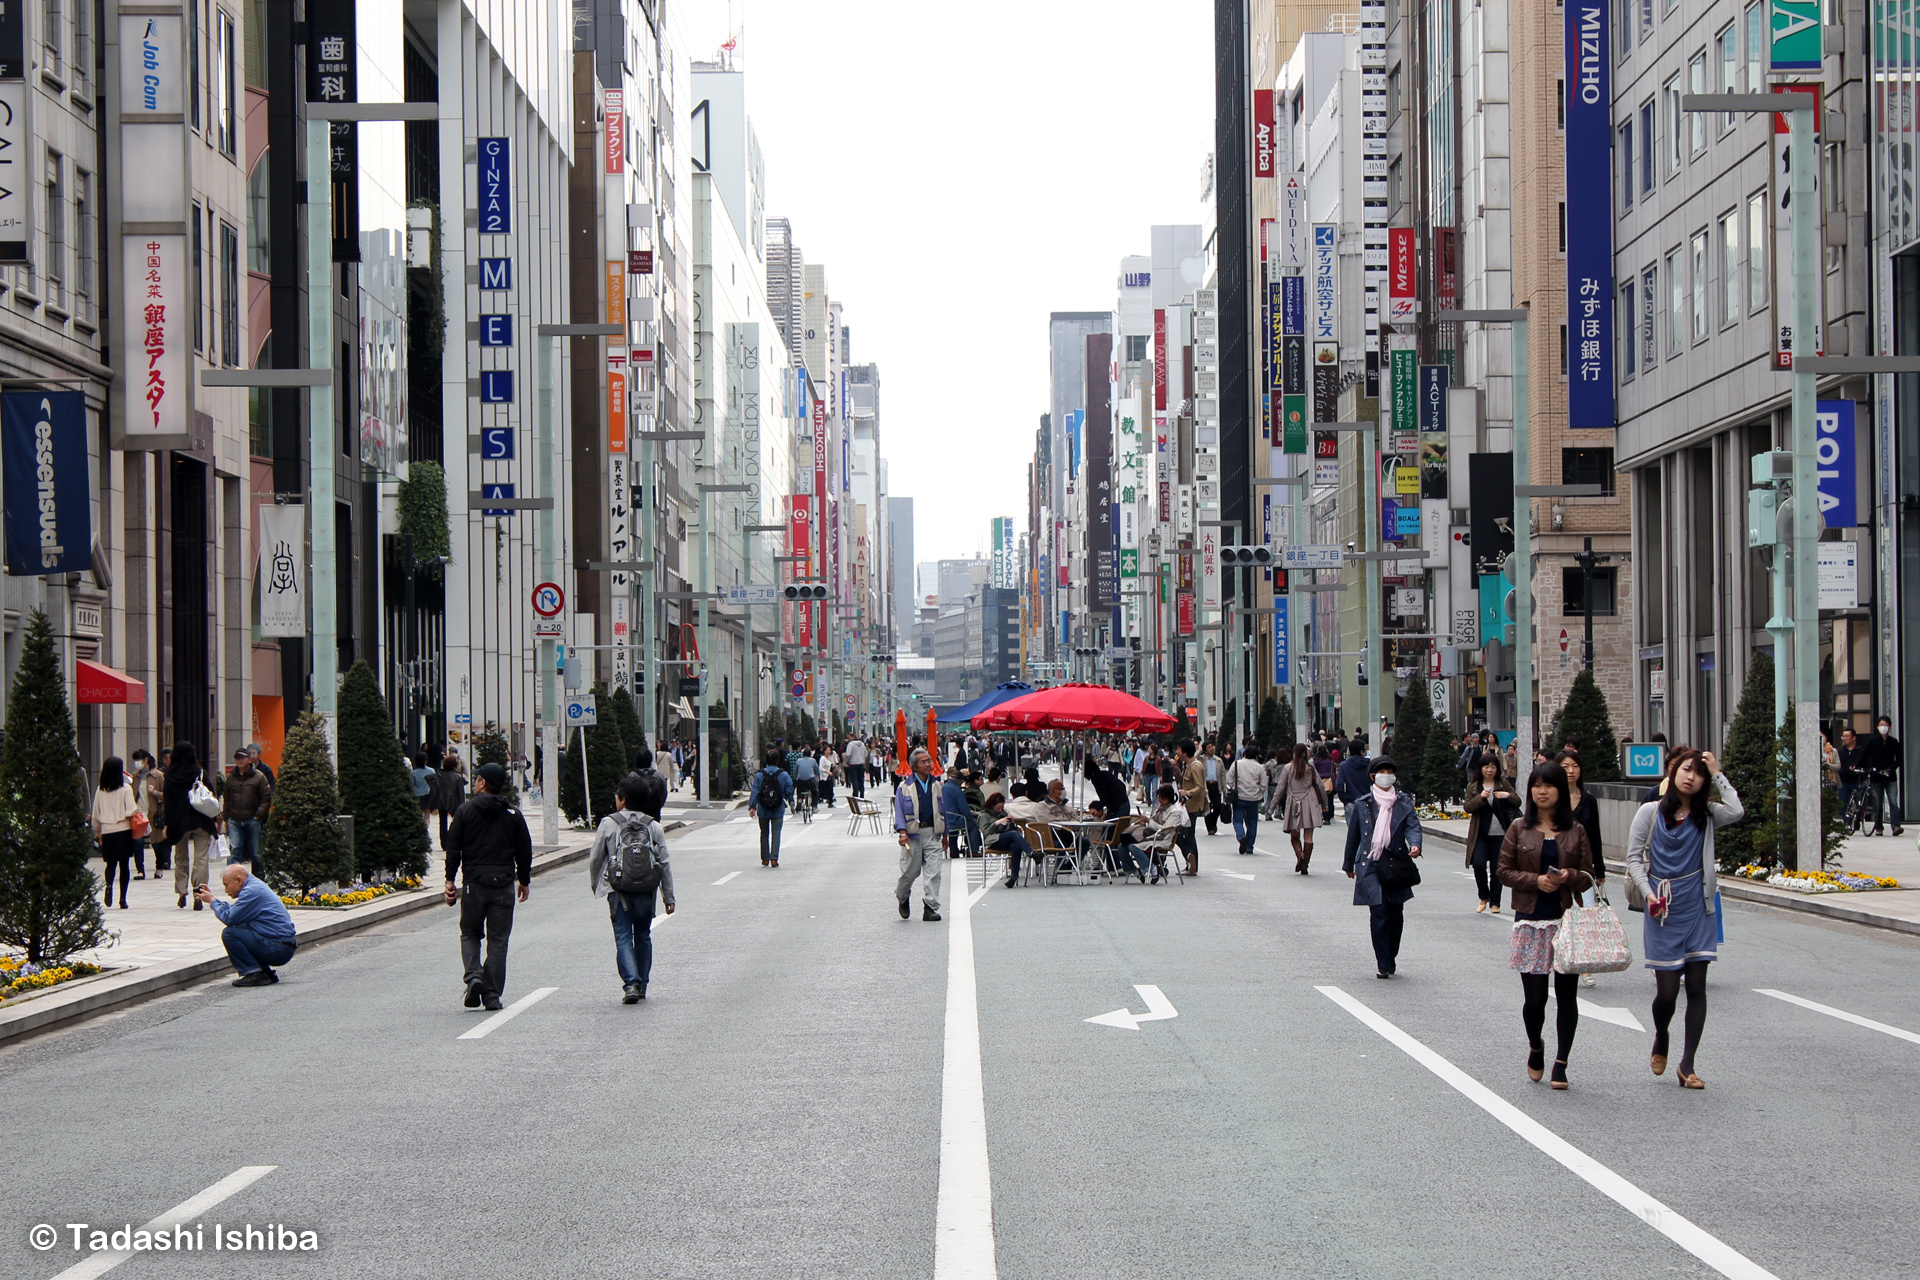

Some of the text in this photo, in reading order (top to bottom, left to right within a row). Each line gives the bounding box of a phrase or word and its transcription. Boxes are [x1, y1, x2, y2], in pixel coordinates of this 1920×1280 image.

[143, 41, 159, 110] Job Com
[318, 63, 348, 73] 聖和歯科
[1581, 7, 1600, 104] MIZUHO
[608, 114, 620, 170] ブラクシー
[1256, 122, 1273, 172] Aprica
[145, 241, 163, 299] 中国名菜
[1125, 272, 1151, 287] 山野
[1397, 235, 1407, 291] Messe
[1317, 246, 1334, 337] テック航空サービス
[1580, 278, 1601, 381] みずほ銀行
[144, 303, 166, 429] 銀座アスター
[1155, 343, 1166, 388] TAMAYA
[1395, 353, 1404, 428] ヒューマンアカデミー
[1405, 353, 1413, 427] 資格取得・キャリアアップ
[815, 404, 825, 472] MITSUKOSHI
[1121, 416, 1136, 504] 教文館
[1816, 411, 1840, 512] POLA
[34, 420, 66, 568] essensuals
[611, 504, 628, 586] ルノアル
[1122, 553, 1137, 573] 本
[1203, 533, 1215, 576] 大和証券
[1286, 550, 1339, 560] 銀座一丁目
[1432, 525, 1440, 558] BRIDAL
[730, 589, 775, 598] 銀座一丁目
[1456, 610, 1464, 644] GINZA
[1464, 610, 1475, 644] PRGR
[79, 687, 123, 698] CHACOK
